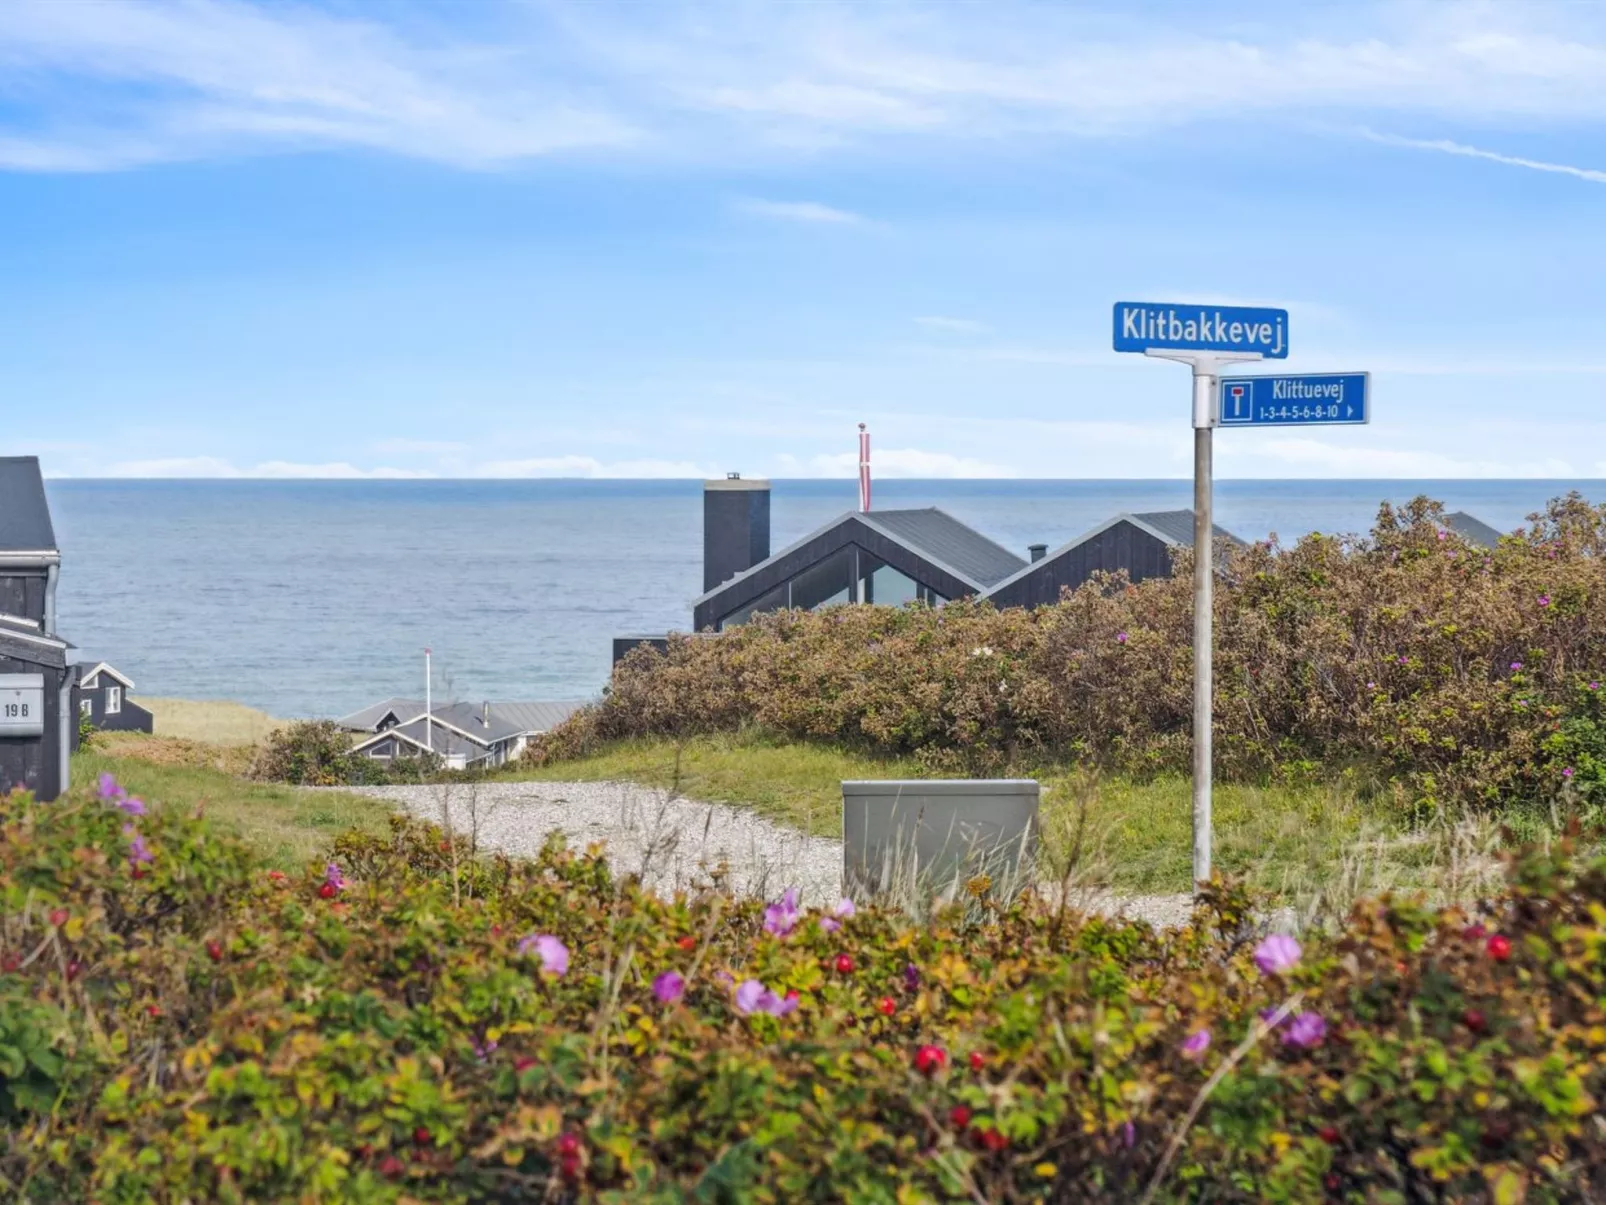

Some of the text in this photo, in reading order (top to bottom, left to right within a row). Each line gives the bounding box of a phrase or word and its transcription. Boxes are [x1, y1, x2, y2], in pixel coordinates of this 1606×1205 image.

[1122, 307, 1283, 354] Klitbakkevej
[1272, 379, 1344, 404] Klittuevej
[1260, 405, 1339, 420] 1-3-4-5-6-8-10
[5, 704, 28, 717] 19 B
